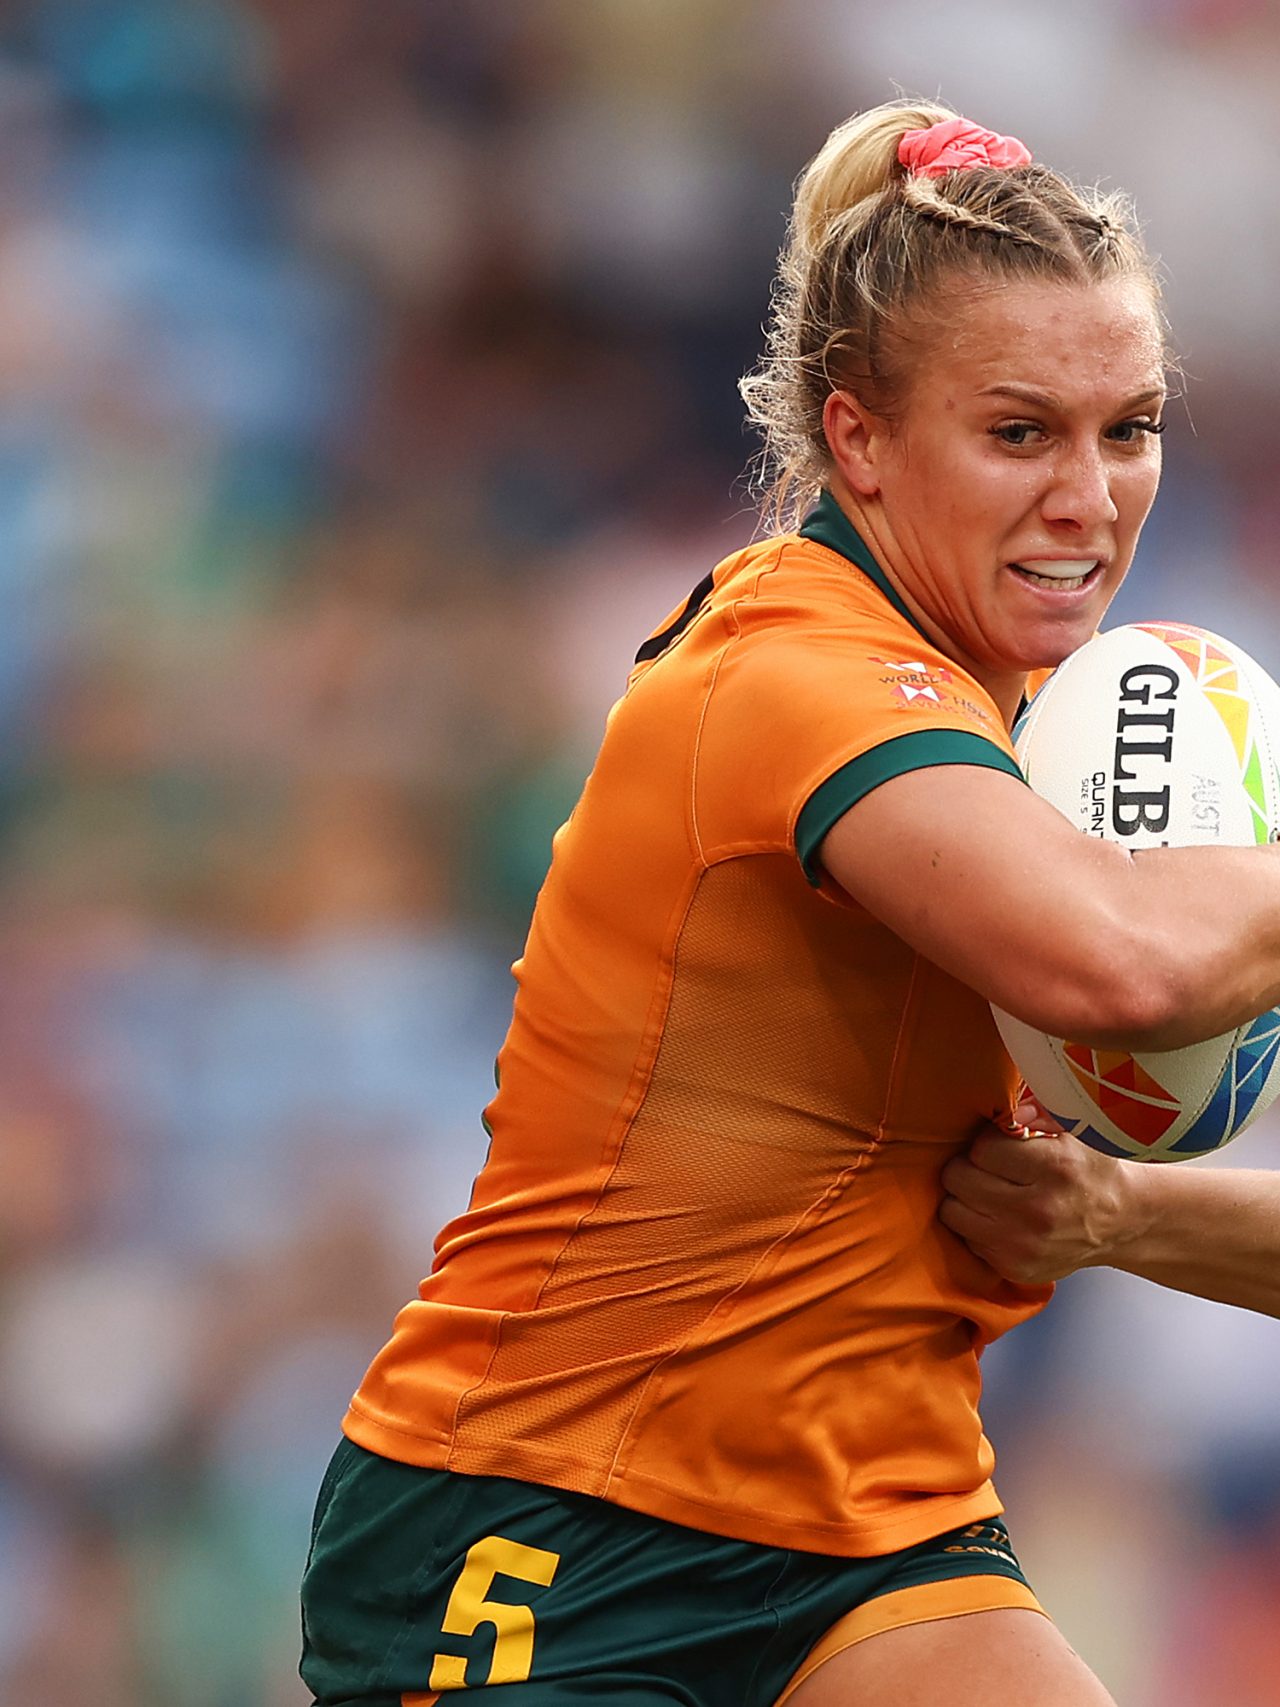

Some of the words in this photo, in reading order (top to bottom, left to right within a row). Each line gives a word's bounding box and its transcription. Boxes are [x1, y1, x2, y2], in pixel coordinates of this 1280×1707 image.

[1091, 771, 1106, 839] QUAN
[1112, 663, 1181, 848] GILB
[428, 1535, 561, 1692] 5
